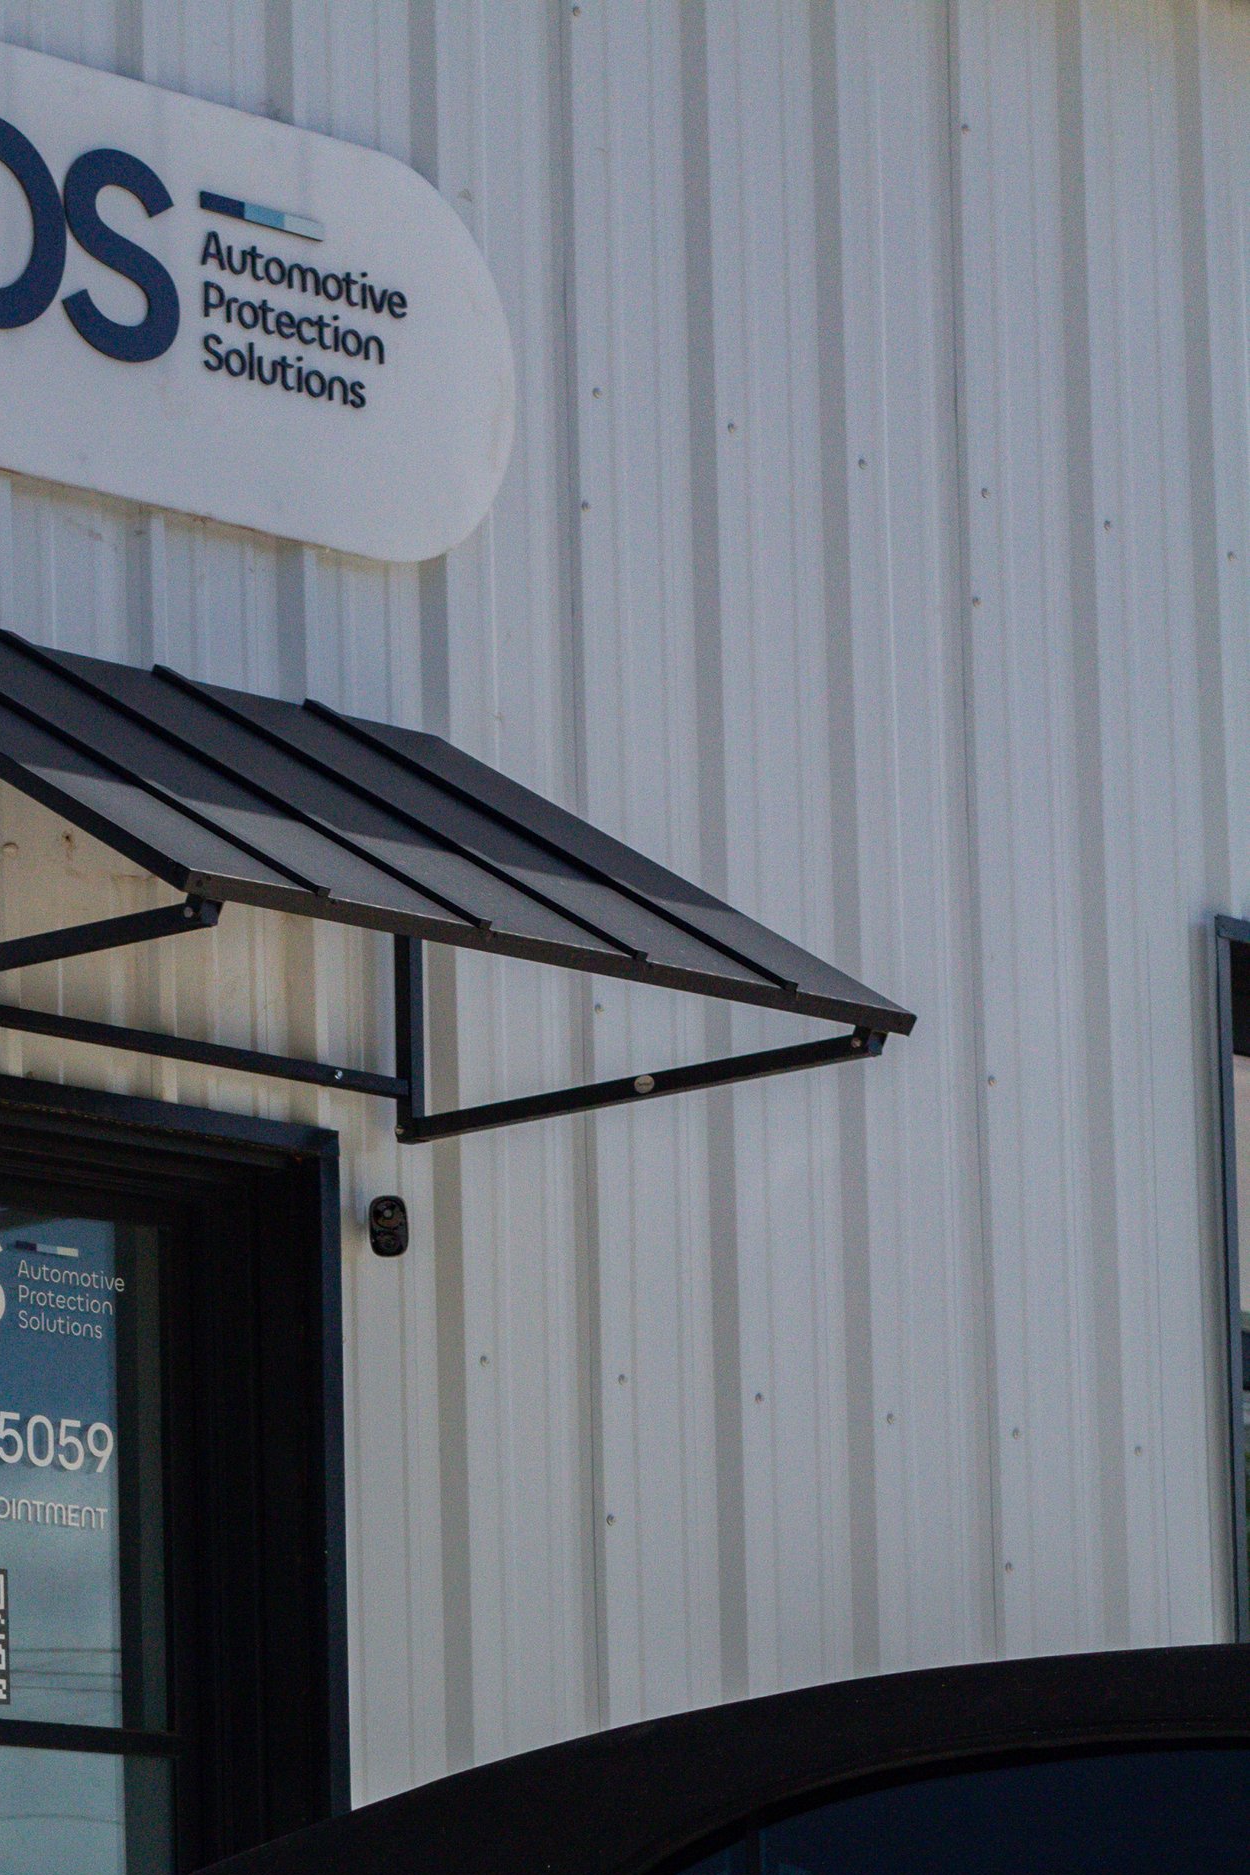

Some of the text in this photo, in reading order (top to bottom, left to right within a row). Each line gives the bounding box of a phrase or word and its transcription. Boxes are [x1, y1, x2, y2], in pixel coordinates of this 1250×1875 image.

[200, 230, 408, 320] Automotive
[201, 282, 386, 366] Protection
[202, 334, 367, 409] Solutions
[17, 1259, 125, 1292] Automotive
[18, 1284, 113, 1315] Protection
[18, 1310, 103, 1339] Solutions
